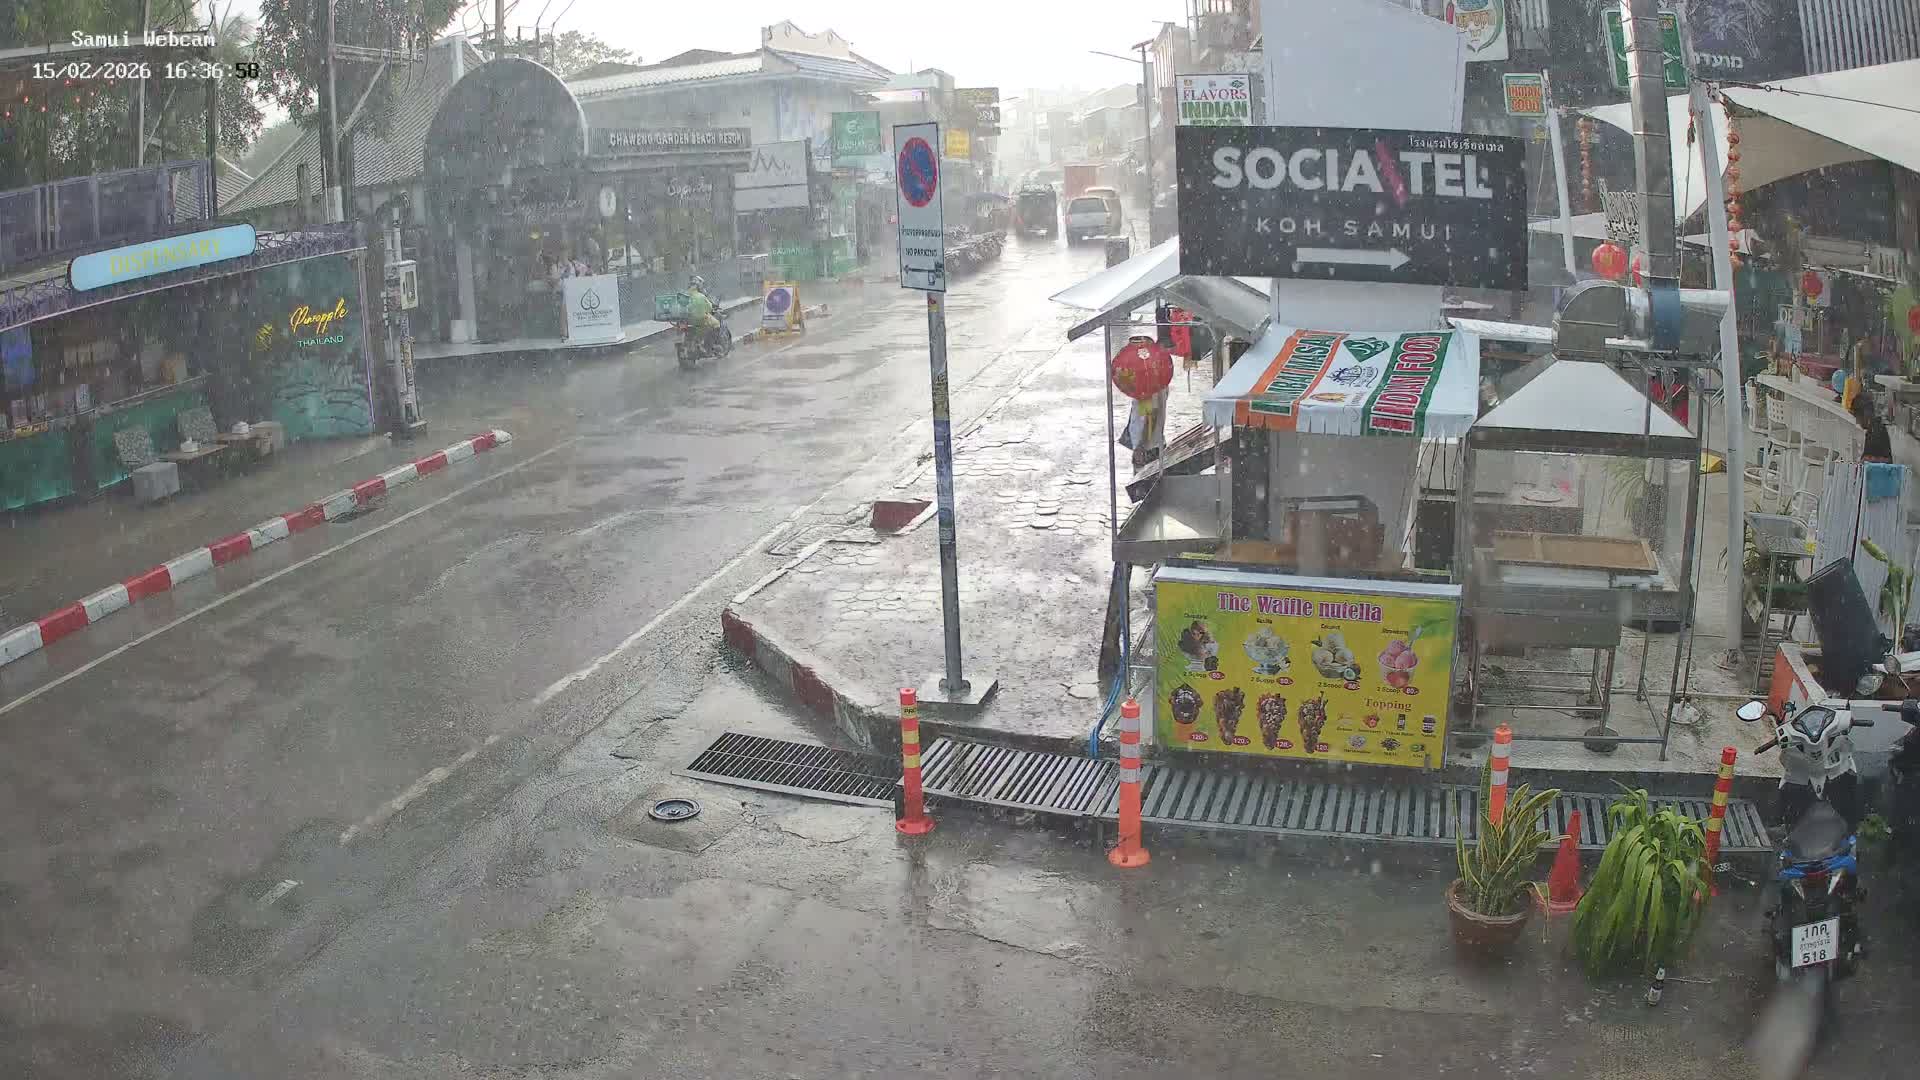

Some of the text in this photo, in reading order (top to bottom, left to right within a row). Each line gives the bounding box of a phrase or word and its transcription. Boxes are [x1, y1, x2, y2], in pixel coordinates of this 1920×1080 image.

[1183, 88, 1248, 100] FLAVORS
[1507, 85, 1542, 98] INDIAN
[1181, 101, 1249, 119] INDIAN
[656, 132, 689, 145] GARDEN
[691, 131, 716, 145] BEACH
[1256, 216, 1453, 240] KOH SAMUI
[110, 238, 222, 277] DISPENSARY
[905, 247, 938, 257] NO PARKING
[298, 335, 344, 348] THAILAND
[1394, 335, 1442, 372] FOOD
[1370, 375, 1431, 433] INDIAN
[1217, 592, 1384, 623] The Waffle nutella
[1364, 697, 1412, 712] Topping
[1803, 949, 1826, 963] 518
